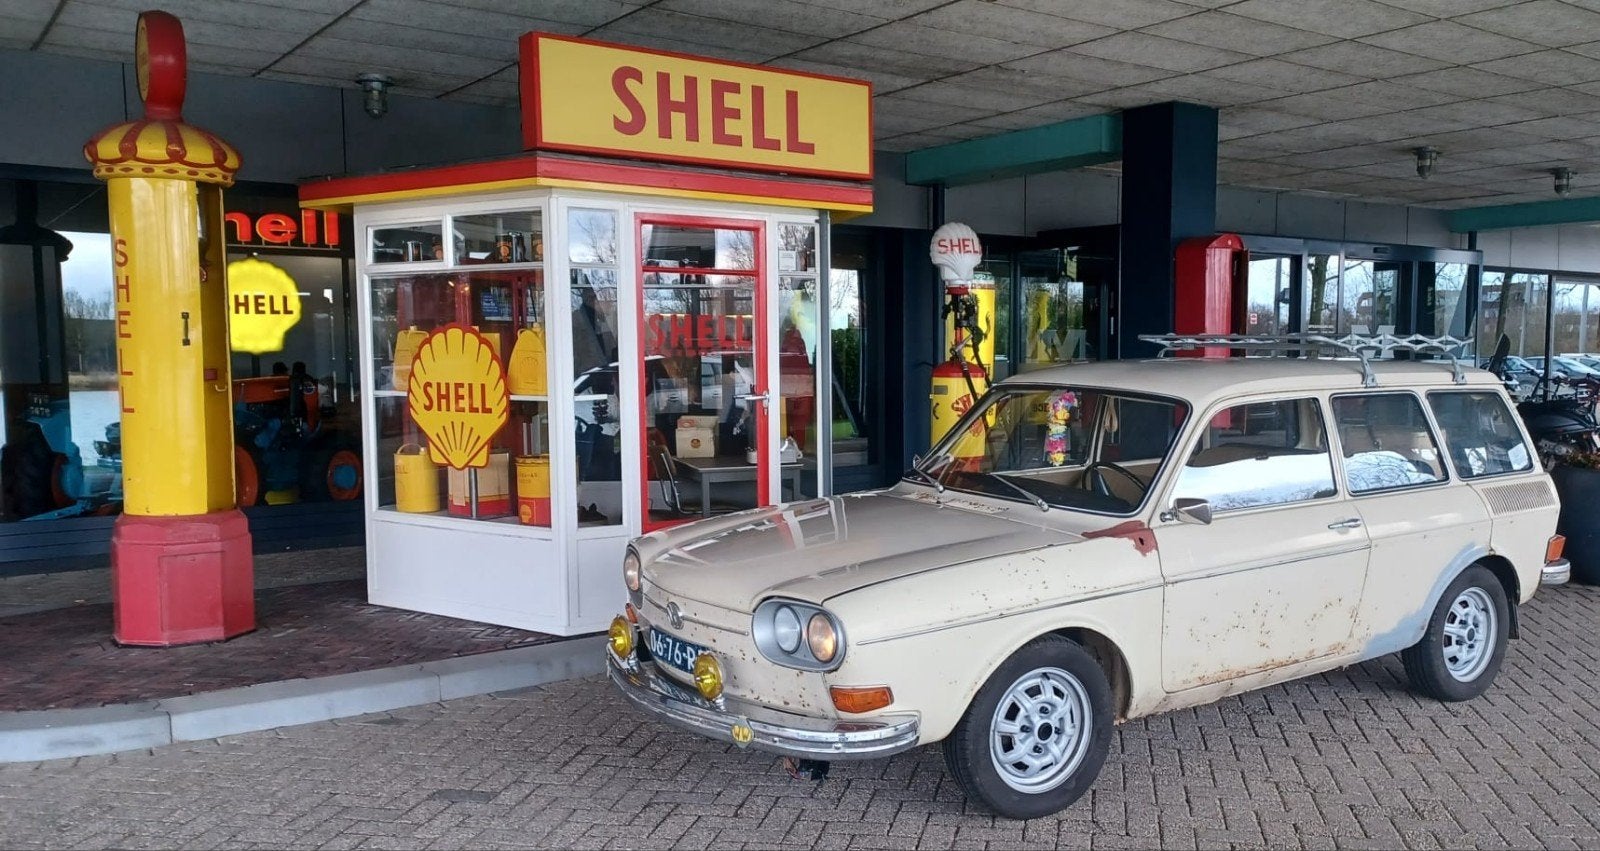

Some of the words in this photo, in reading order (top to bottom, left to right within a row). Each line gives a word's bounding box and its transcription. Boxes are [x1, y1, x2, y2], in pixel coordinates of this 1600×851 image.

[611, 66, 816, 155] SHELL
[938, 238, 982, 255] SHEL
[229, 295, 294, 315] HELL
[114, 239, 135, 413] SHELL
[648, 313, 752, 349] SHELL
[423, 381, 493, 414] SHELL
[650, 629, 710, 671] 06-76-R
